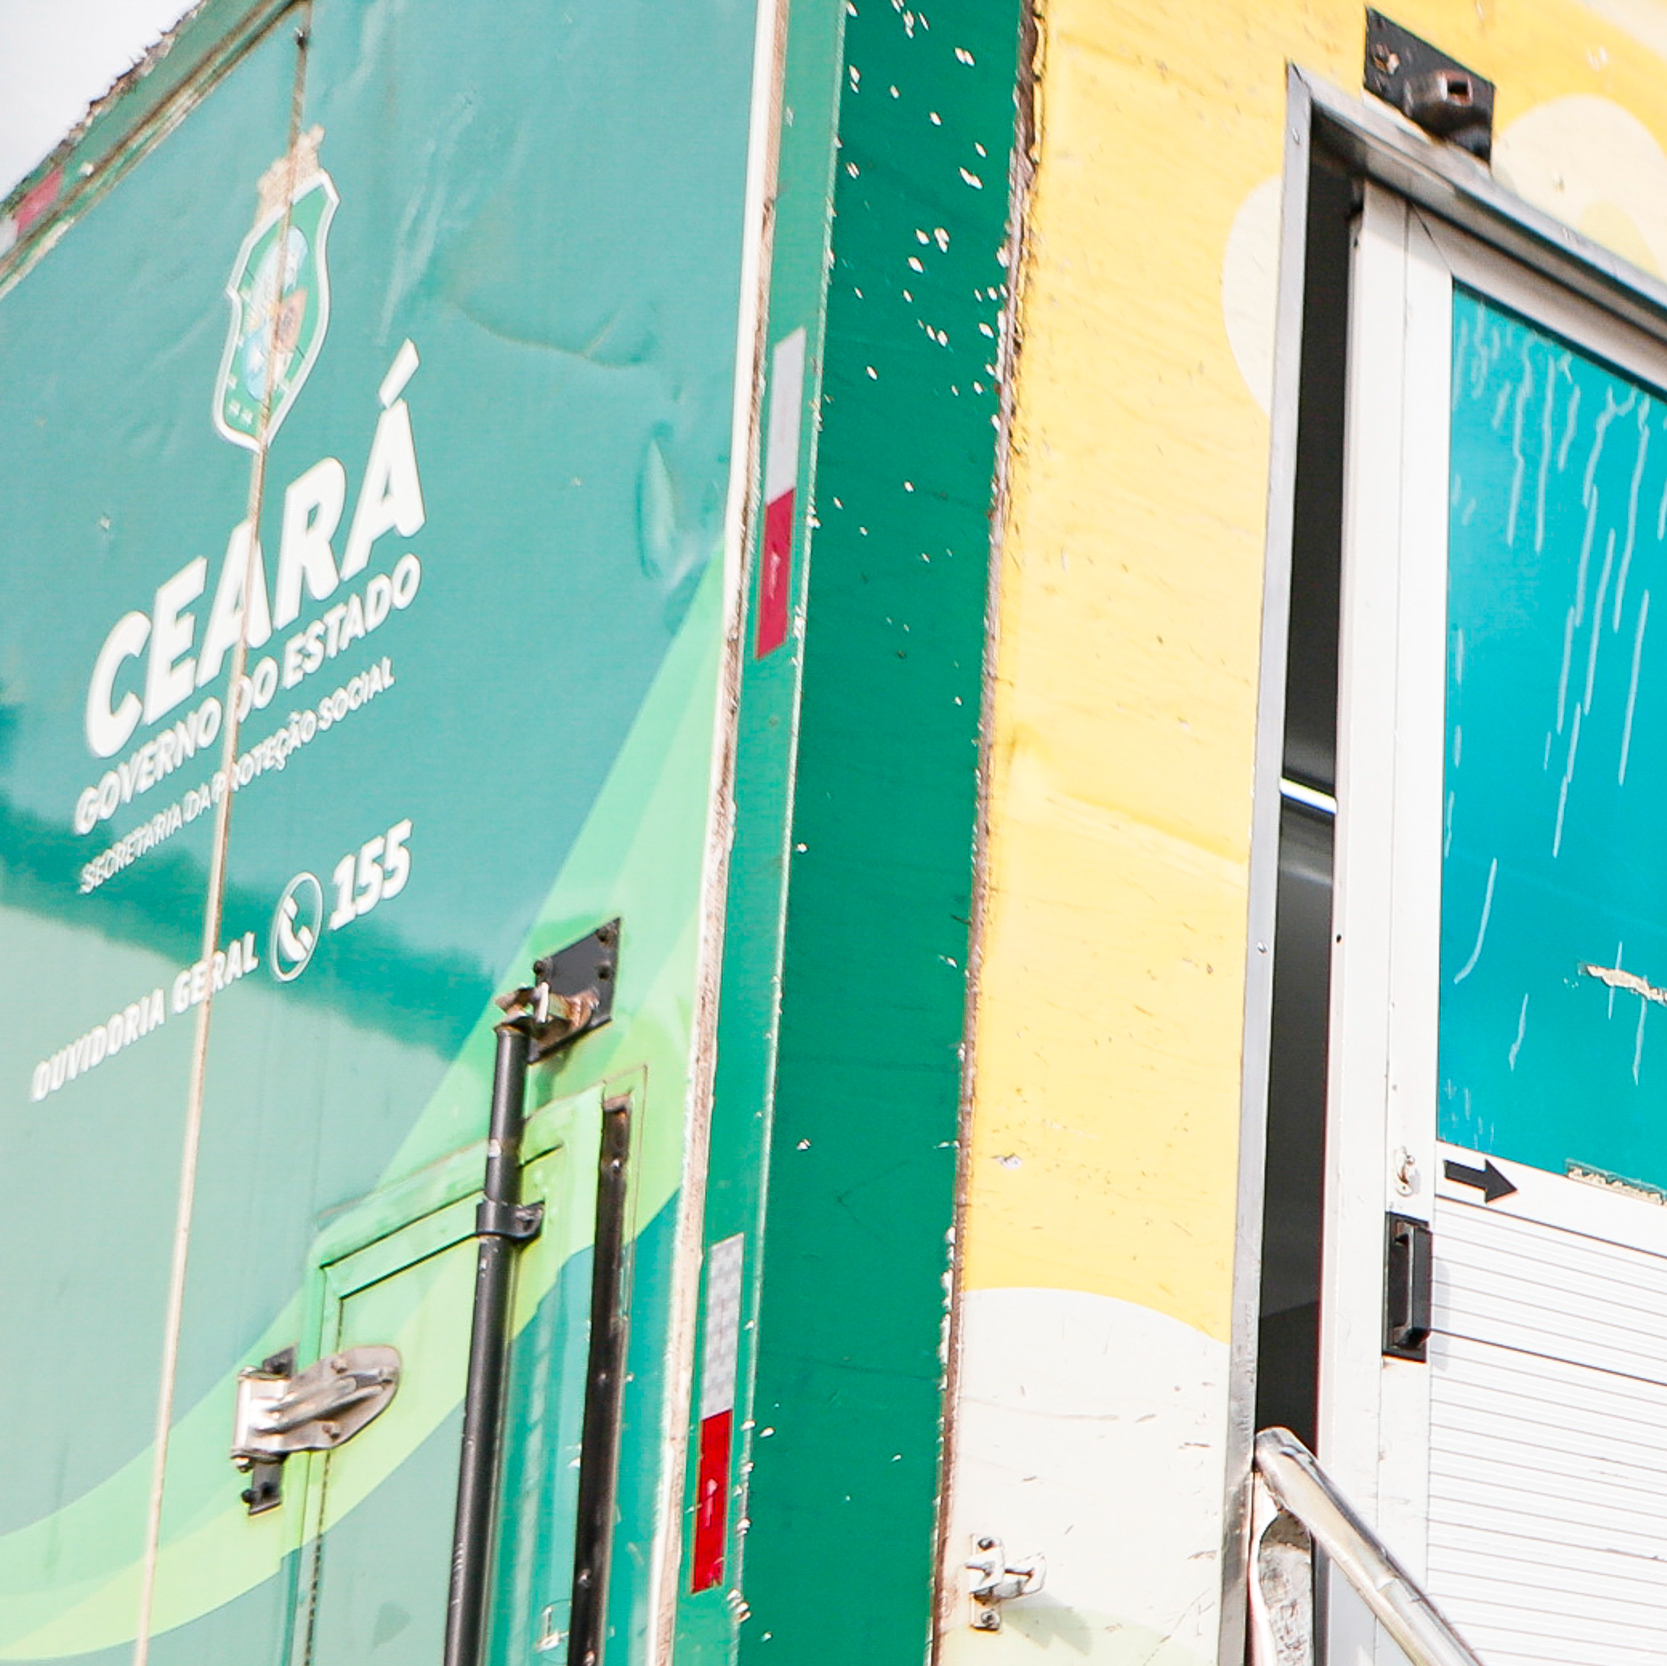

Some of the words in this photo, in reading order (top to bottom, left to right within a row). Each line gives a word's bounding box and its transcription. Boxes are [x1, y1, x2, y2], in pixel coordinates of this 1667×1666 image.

[85, 337, 426, 759] CEARÁ
[74, 696, 222, 835] GOVERNO
[281, 552, 421, 690] ESTADO
[78, 803, 184, 894] SECRETARIA
[183, 783, 211, 823] DA
[317, 656, 396, 732] SOCIAL
[31, 988, 166, 1102] OUVIDORIA
[171, 931, 259, 1015] GERAL
[328, 818, 413, 931] 155
